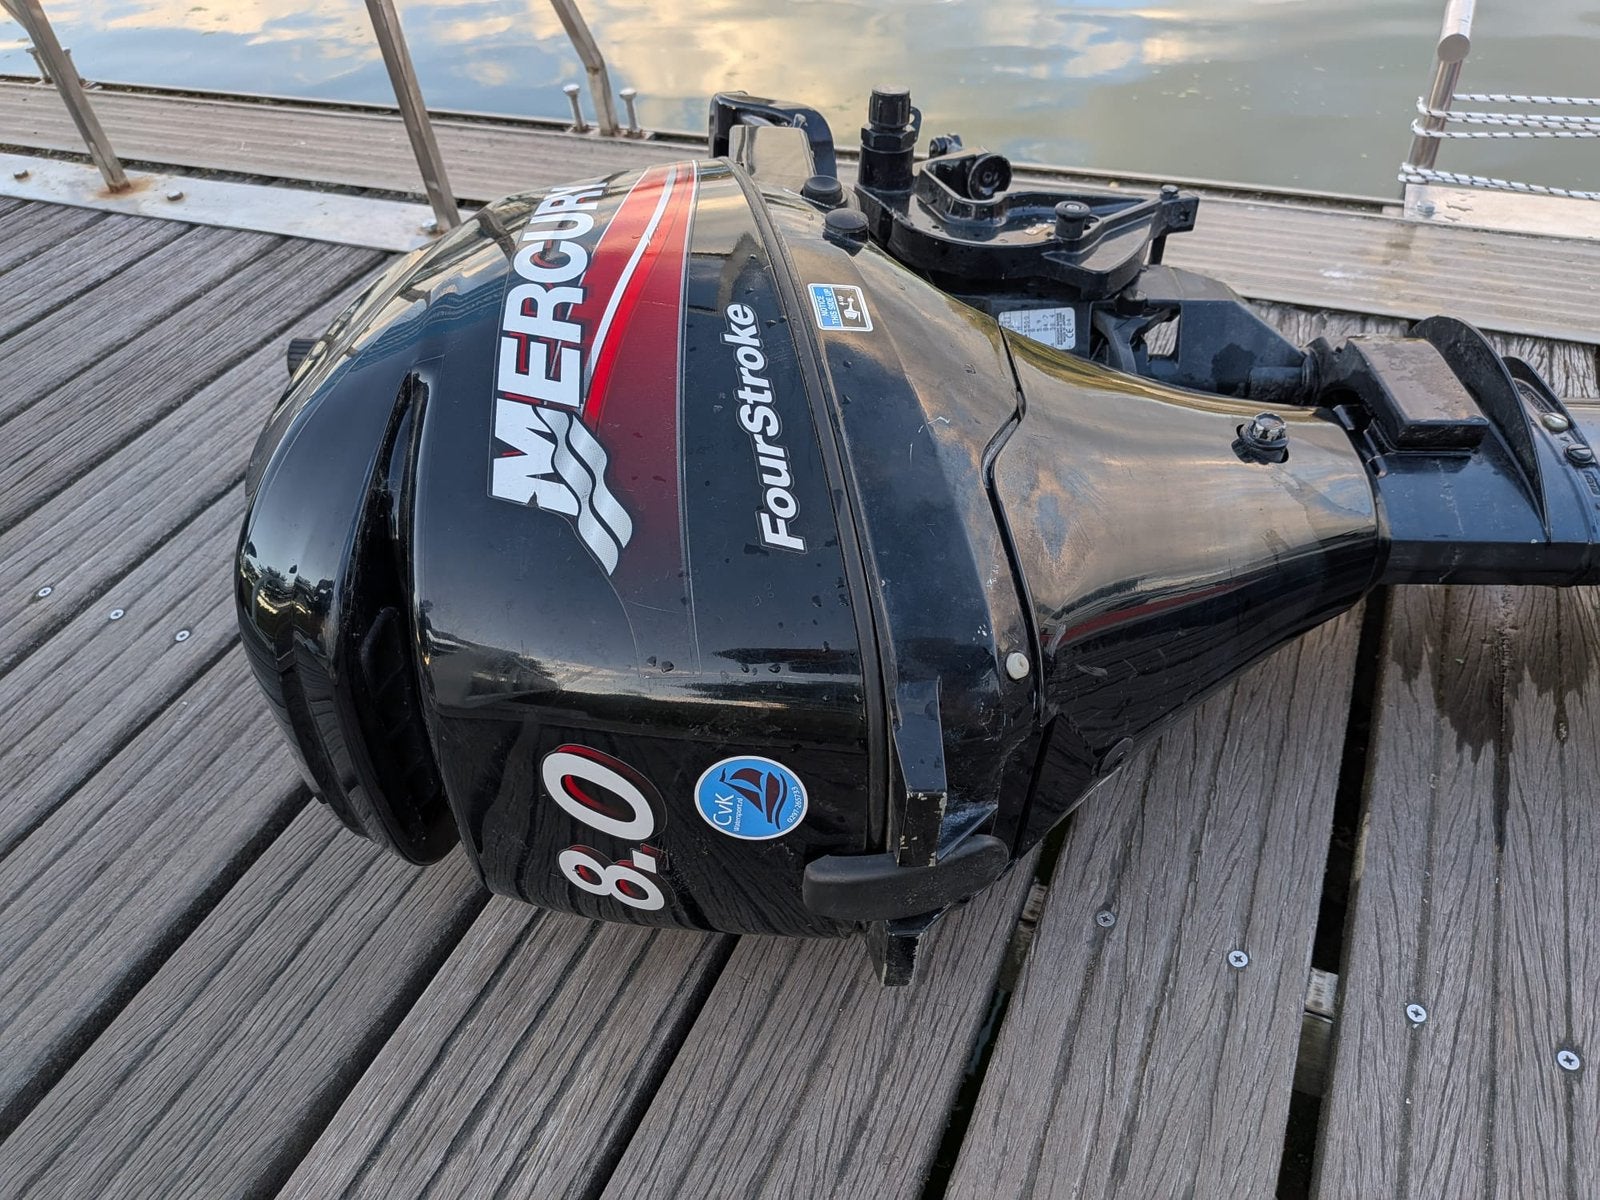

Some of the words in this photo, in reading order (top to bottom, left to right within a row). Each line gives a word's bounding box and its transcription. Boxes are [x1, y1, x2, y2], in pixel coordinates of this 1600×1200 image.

[817, 295, 828, 316] NOTICE
[823, 288, 831, 297] UP
[826, 298, 835, 310] SIDE
[830, 310, 840, 324] THIS
[491, 181, 608, 516] MERCURY
[721, 303, 805, 550] FourStroke
[713, 792, 735, 826] CvK
[541, 746, 666, 911] 8.0
